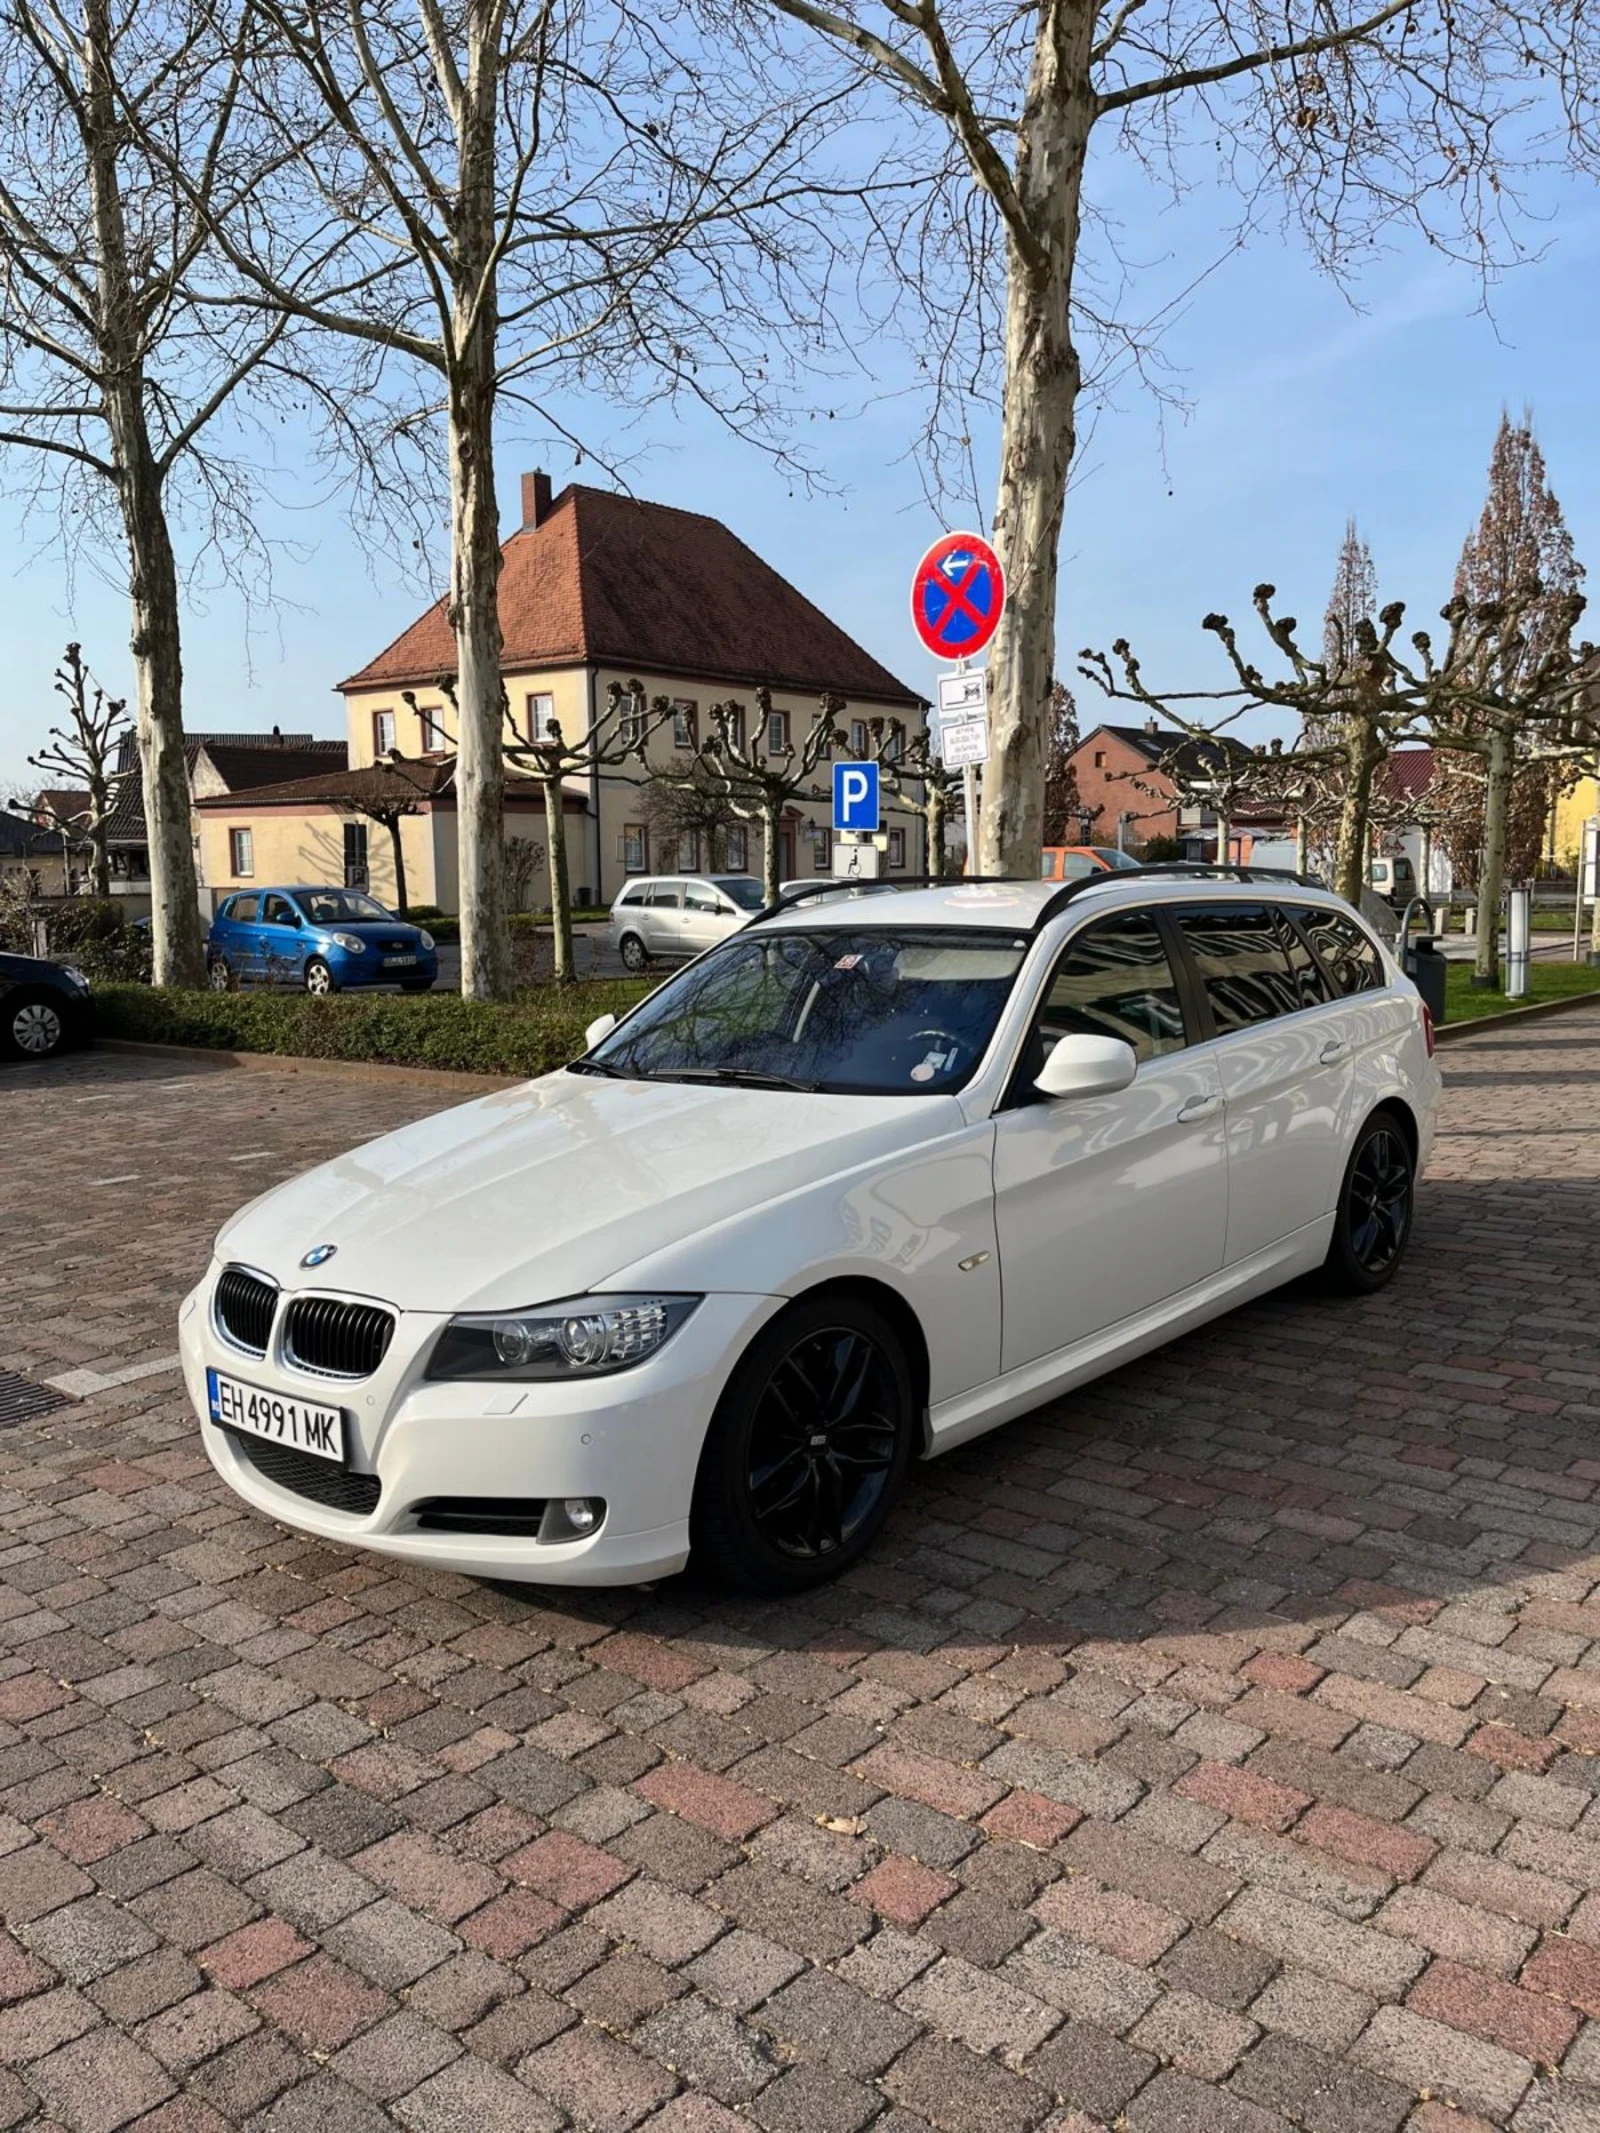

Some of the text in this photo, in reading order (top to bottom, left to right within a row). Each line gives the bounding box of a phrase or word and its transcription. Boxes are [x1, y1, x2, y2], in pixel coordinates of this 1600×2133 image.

[843, 770, 868, 822] P
[220, 1381, 337, 1454] EH 4991 MK
